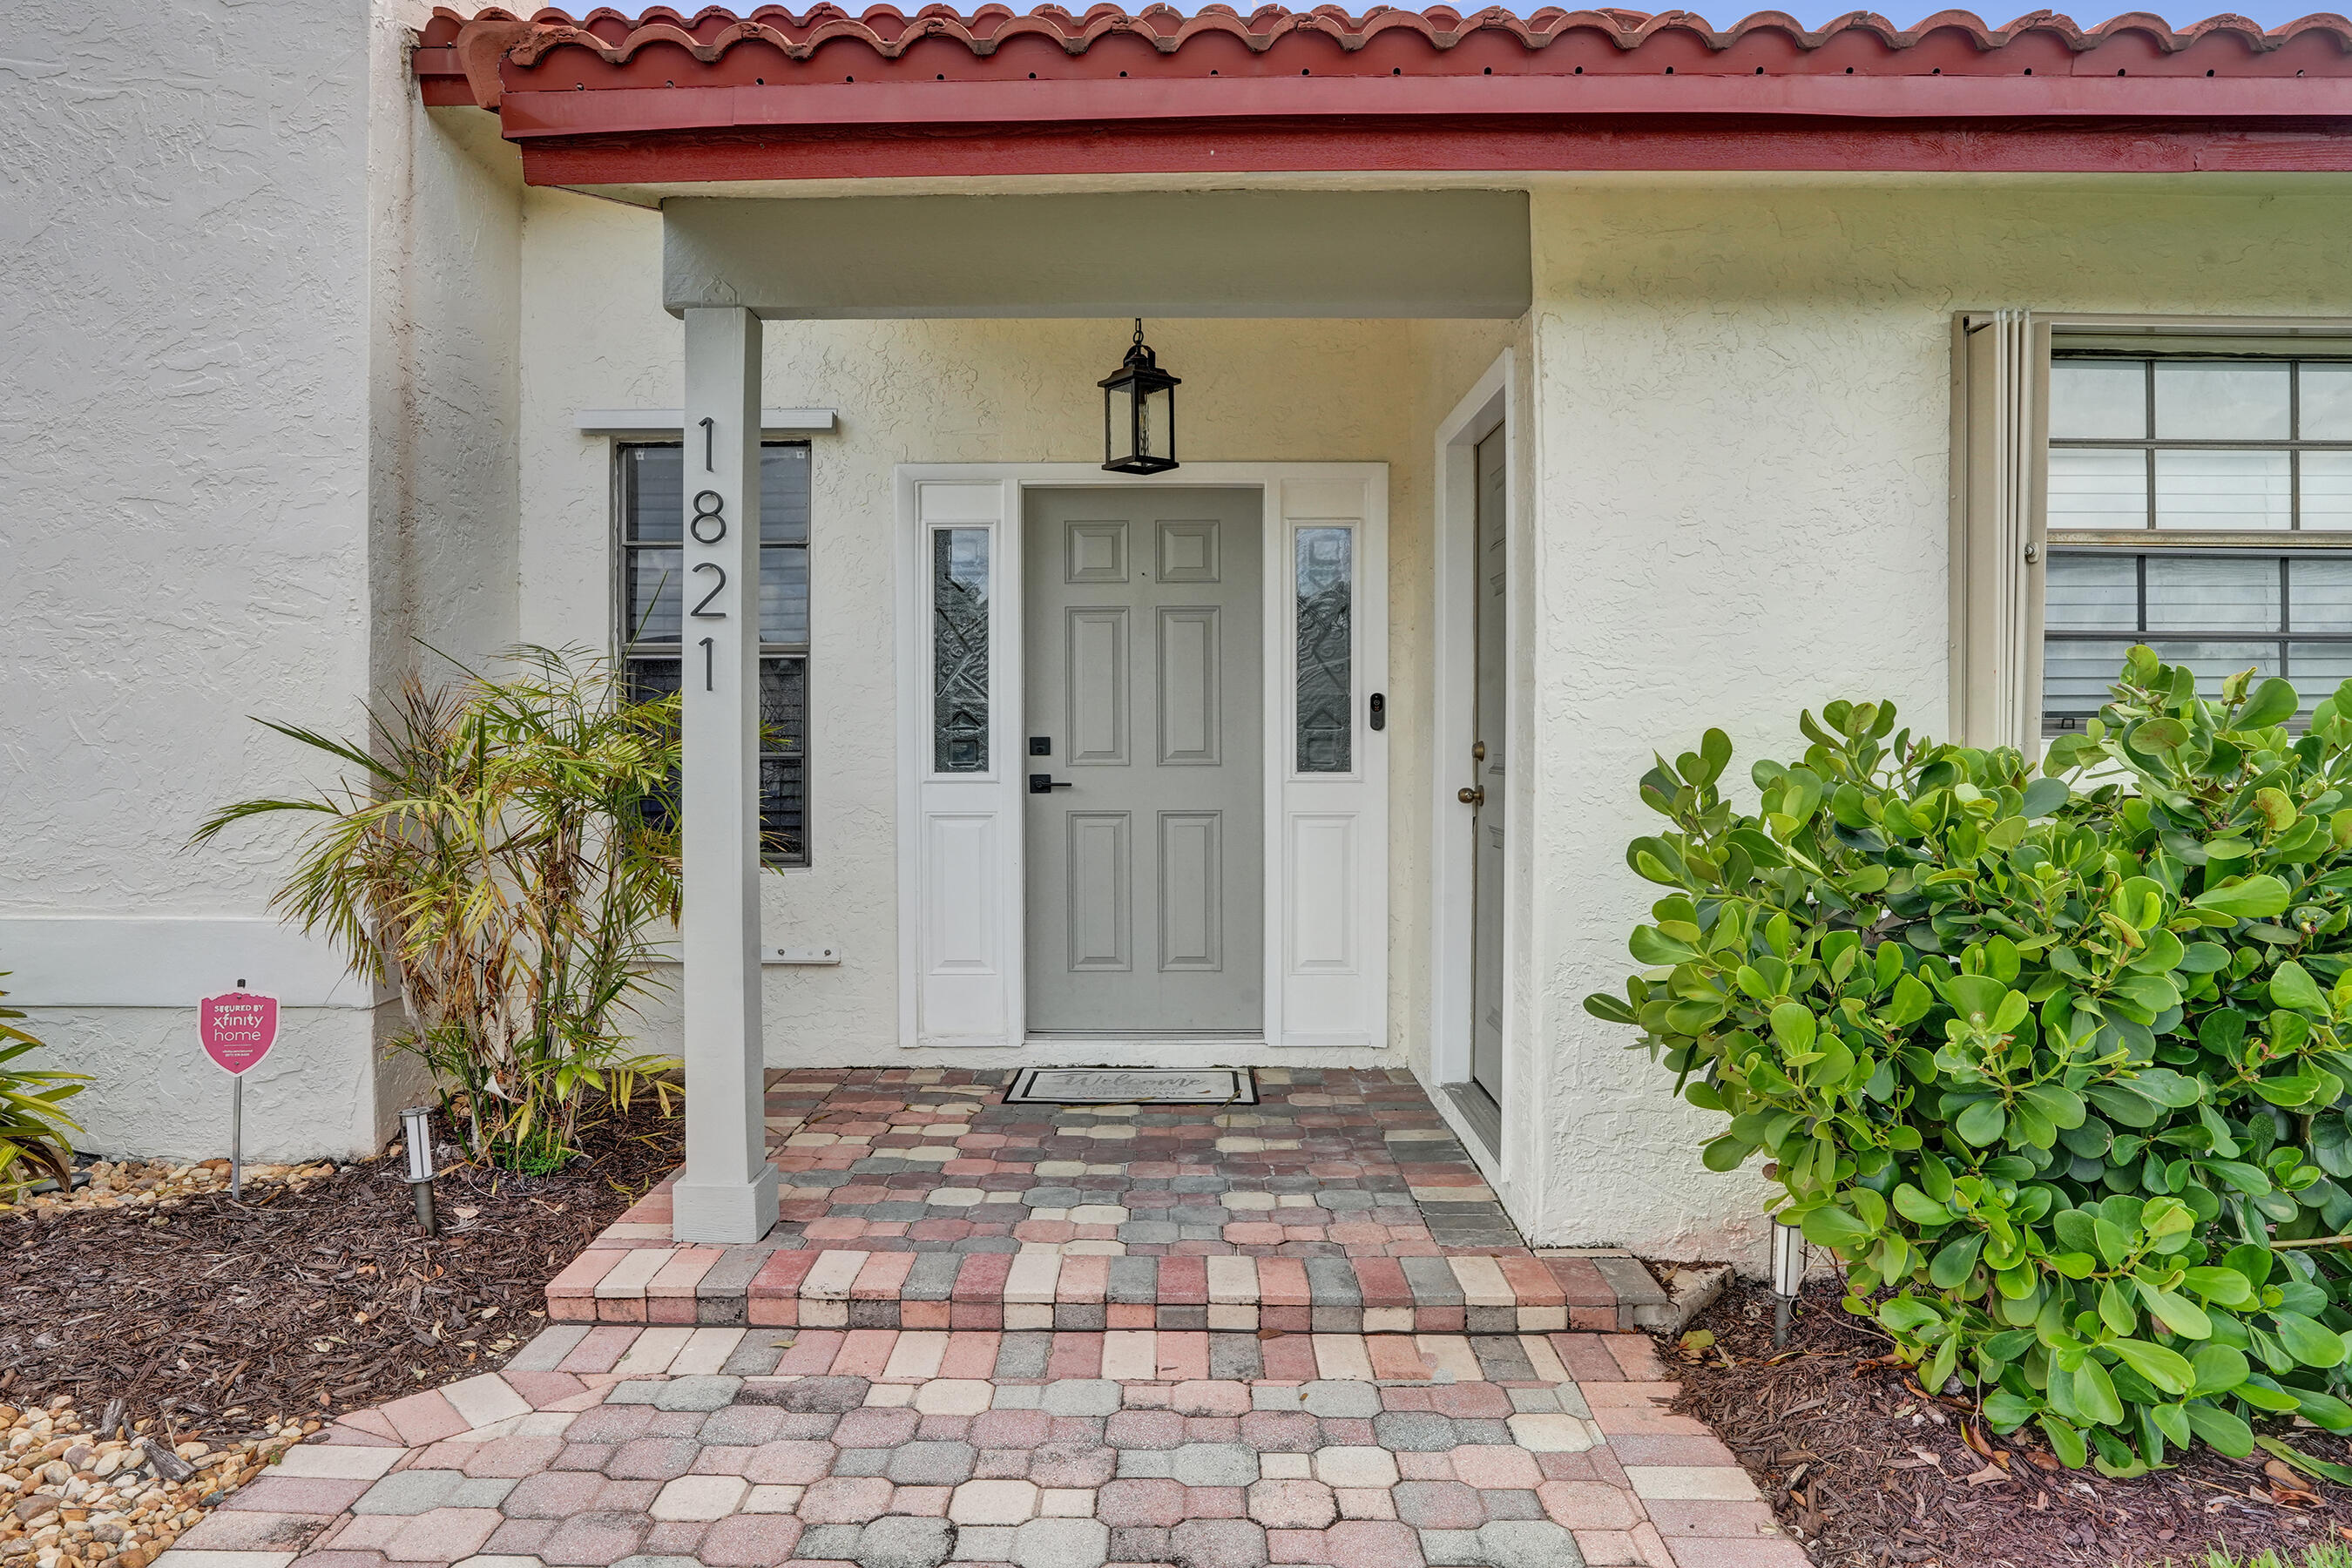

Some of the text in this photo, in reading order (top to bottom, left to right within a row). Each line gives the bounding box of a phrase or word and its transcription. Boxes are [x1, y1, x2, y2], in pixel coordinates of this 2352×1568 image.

[690, 416, 727, 691] 1821
[213, 1013, 264, 1029] xfinity
[214, 1029, 261, 1041] home
[1052, 1072, 1206, 1087] Welcome
